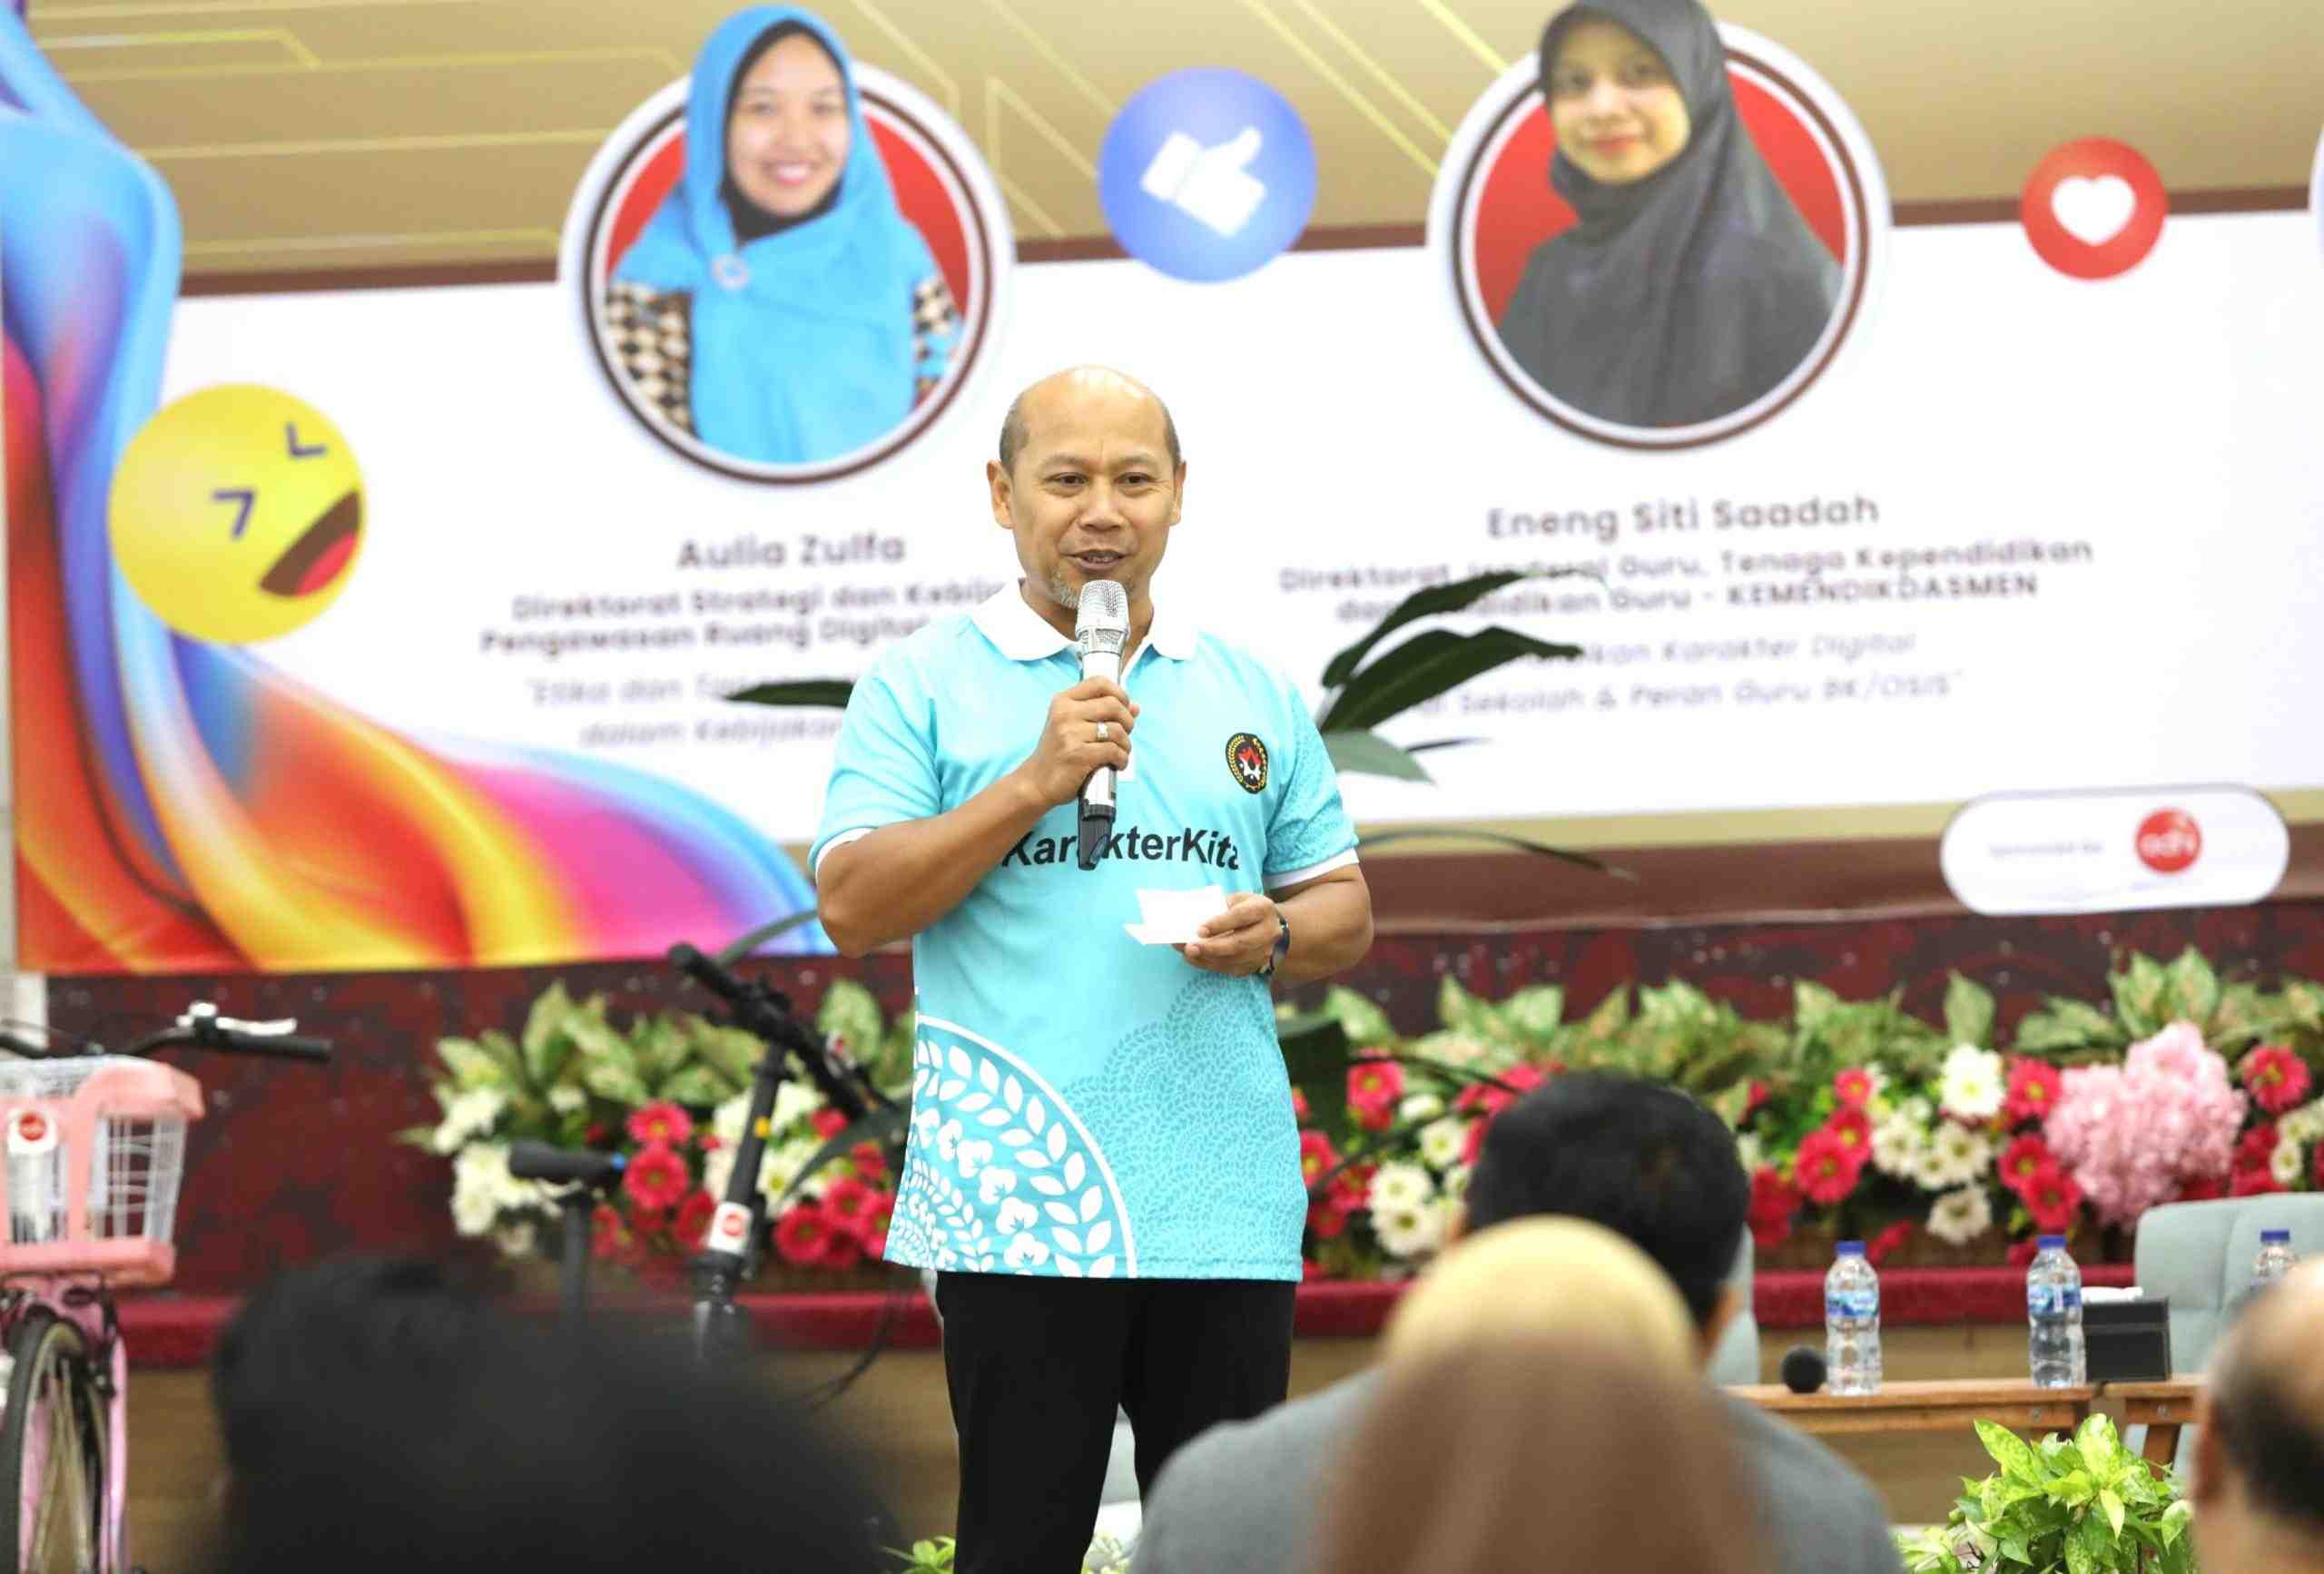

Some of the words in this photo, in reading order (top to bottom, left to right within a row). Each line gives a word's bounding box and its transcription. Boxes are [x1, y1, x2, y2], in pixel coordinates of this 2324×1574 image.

[1488, 507, 1618, 543] Eneng
[1633, 499, 1699, 532] Siti
[1713, 496, 1878, 529] Saadah
[677, 536, 785, 569] Aulia
[800, 532, 906, 566] Zulfa
[1279, 563, 1449, 592] Direktorat
[1721, 546, 1846, 575] Tenaga
[1856, 538, 2093, 572] Kependidikan
[512, 591, 682, 621] Direktorat
[693, 585, 822, 621] Strategi
[832, 581, 897, 610] dan
[1610, 587, 1690, 614] Guru
[1728, 573, 2037, 605] KEMENDIKDASMEN
[480, 625, 694, 659] Pengawasan
[704, 619, 811, 649] Ruang
[1663, 637, 1797, 663] Karakter
[1811, 631, 1916, 664] Digital
[1462, 687, 1585, 714] Sekolah
[1599, 686, 1617, 710] &
[1630, 679, 1722, 707] Peran
[1735, 676, 1811, 704] Guru
